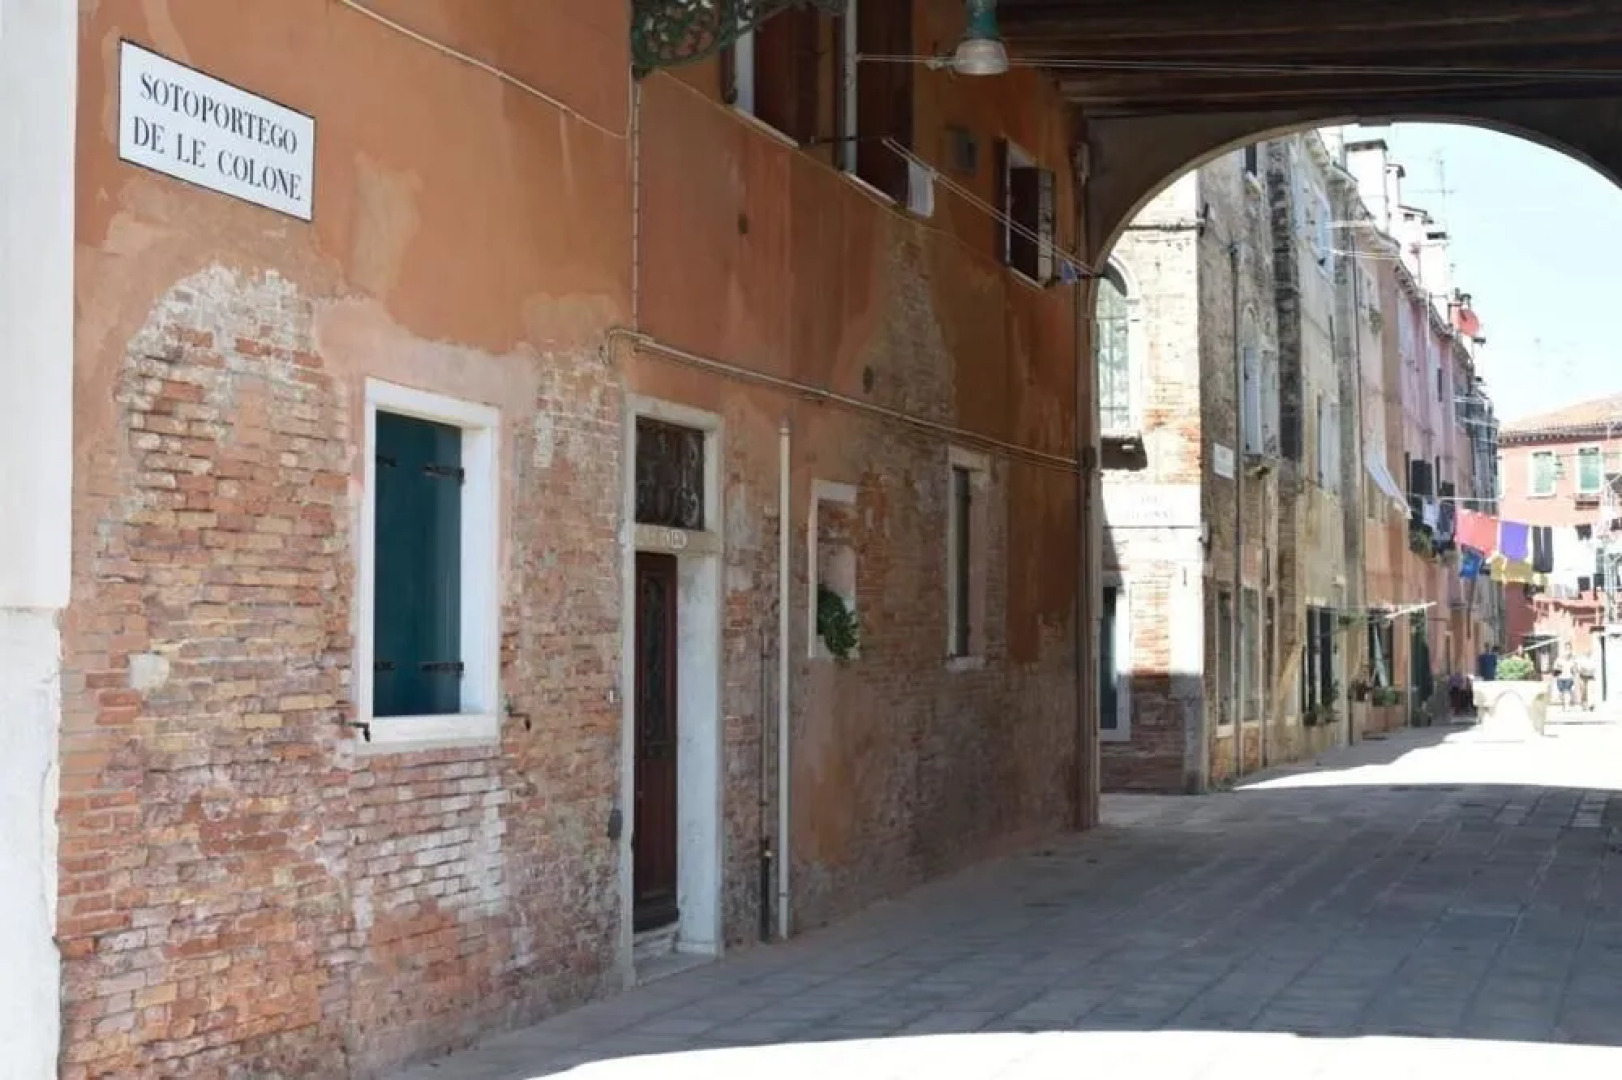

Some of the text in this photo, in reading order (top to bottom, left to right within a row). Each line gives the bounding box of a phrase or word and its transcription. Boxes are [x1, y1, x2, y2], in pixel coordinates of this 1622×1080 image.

[140, 72, 298, 154] SOTOPORTEGO
[133, 116, 301, 201] DE LE COLONE
